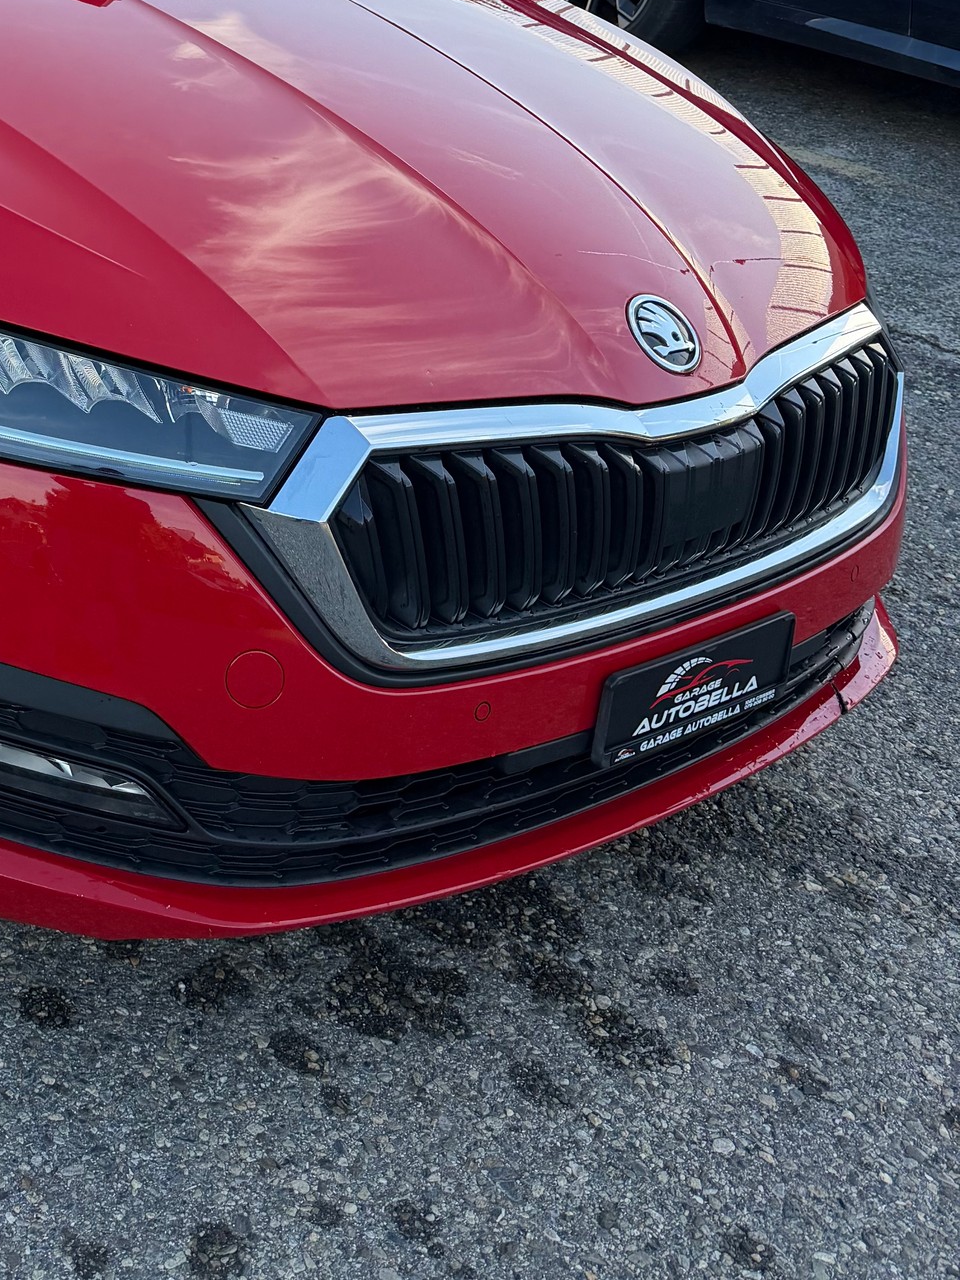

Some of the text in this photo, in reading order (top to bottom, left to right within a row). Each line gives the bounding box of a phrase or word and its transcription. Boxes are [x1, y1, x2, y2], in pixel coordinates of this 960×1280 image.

[632, 675, 759, 737] AUTOBELLA
[674, 677, 723, 704] GARAGE
[640, 704, 741, 752] GARAGE AUTOBELLA
